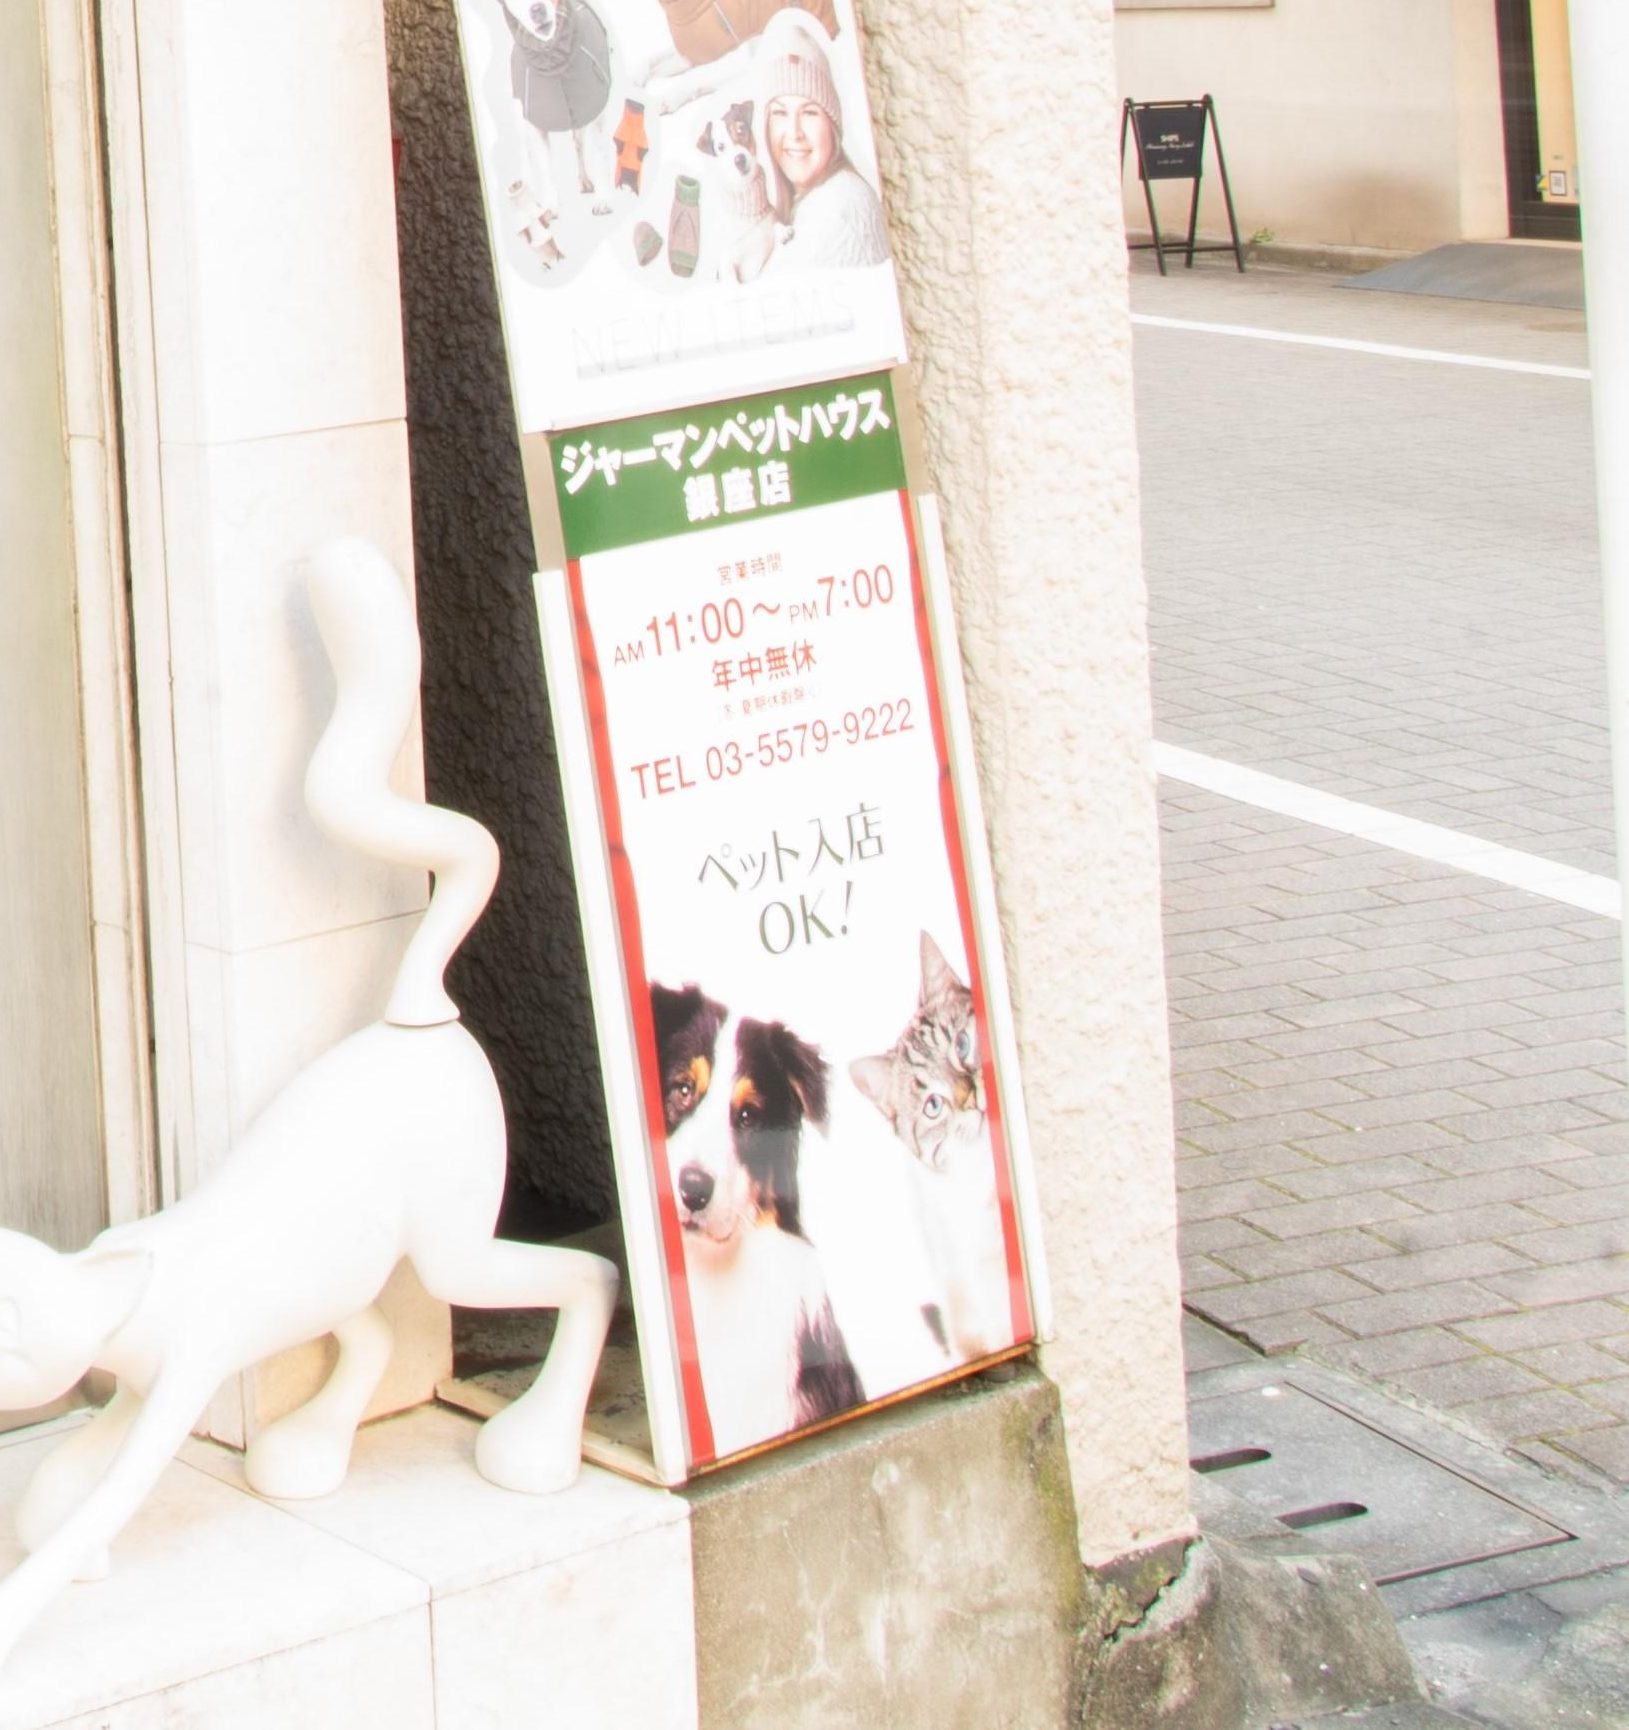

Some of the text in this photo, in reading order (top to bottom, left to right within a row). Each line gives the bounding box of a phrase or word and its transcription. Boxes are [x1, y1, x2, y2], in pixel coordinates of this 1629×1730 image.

[560, 389, 892, 494] ジャーマンペットハウス
[683, 461, 792, 522] 銀座店
[711, 638, 817, 691] 年中無休
[631, 698, 914, 800] TEL 03-5579-9222
[697, 801, 885, 893] ペット入店
[758, 881, 854, 955] OK!
